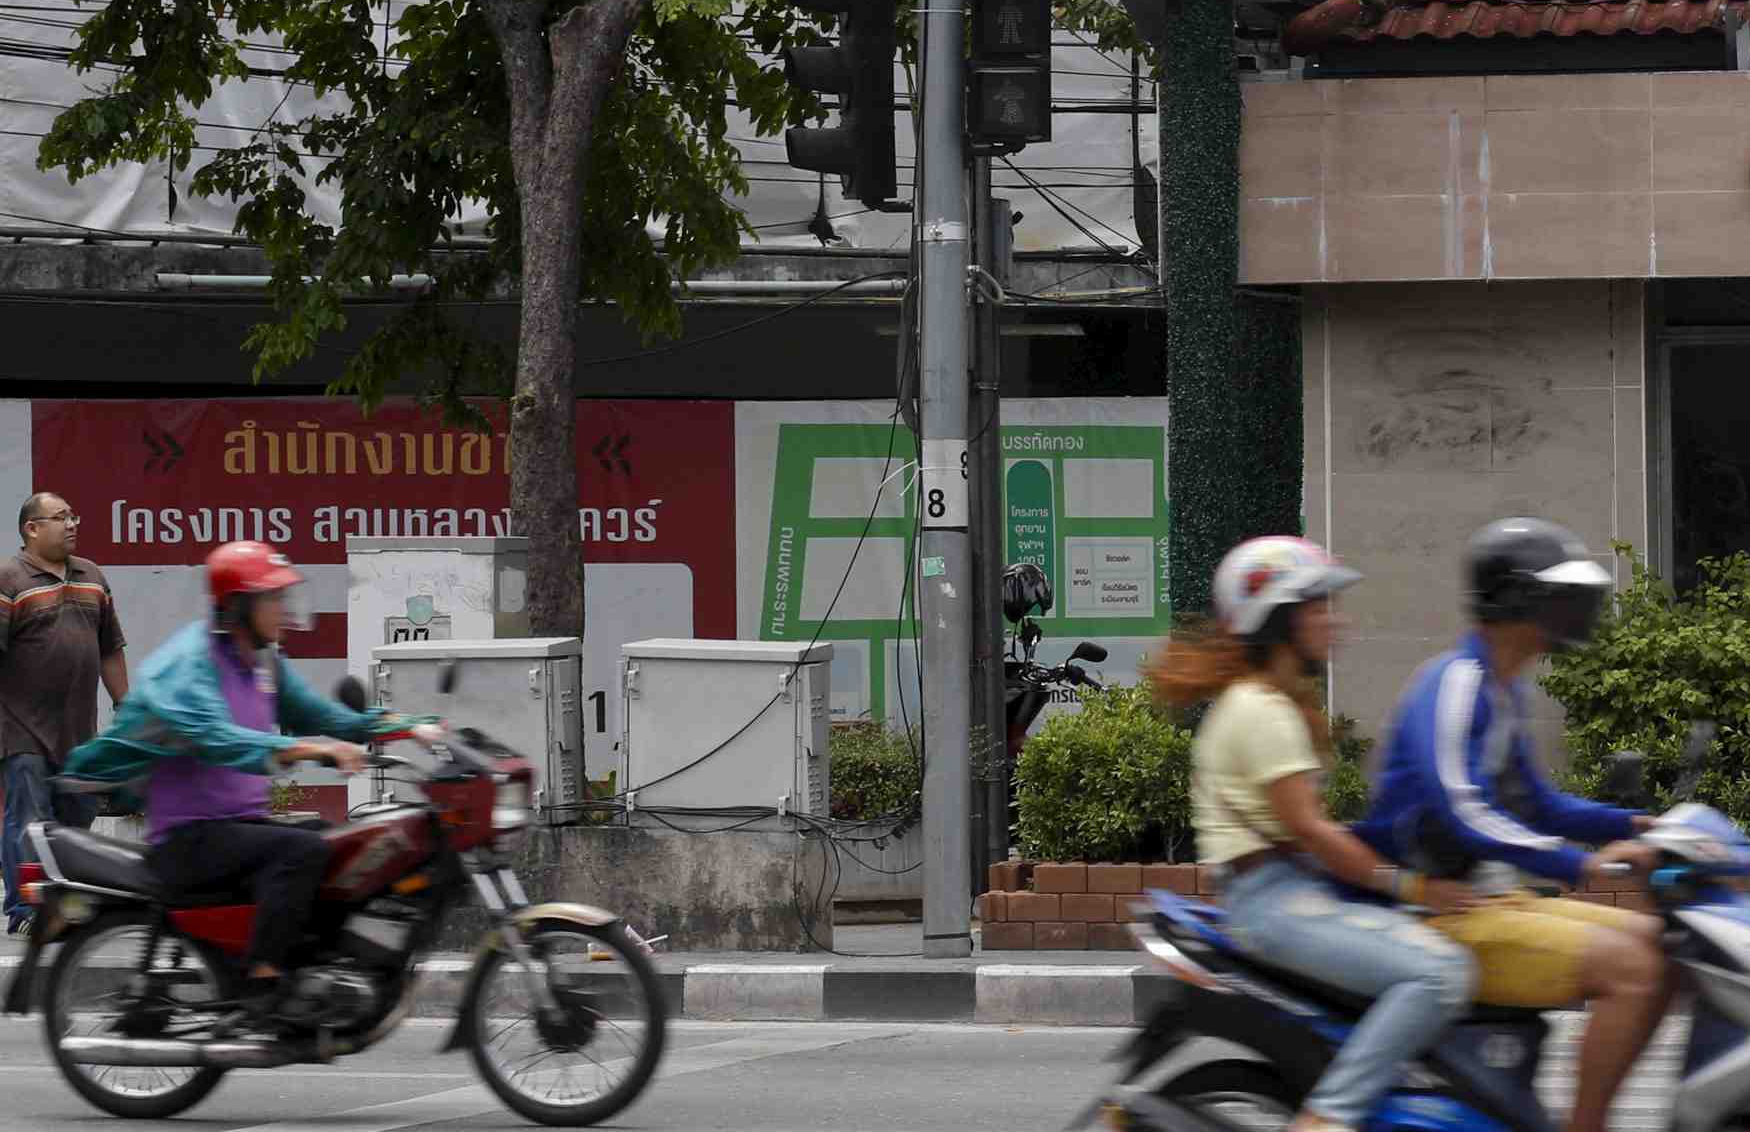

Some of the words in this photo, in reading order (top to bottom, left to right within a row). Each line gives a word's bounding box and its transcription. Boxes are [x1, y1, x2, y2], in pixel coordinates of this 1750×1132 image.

[224, 421, 512, 475] สำนักงานขา
[112, 499, 292, 543] โครงการ
[928, 489, 945, 518] 8
